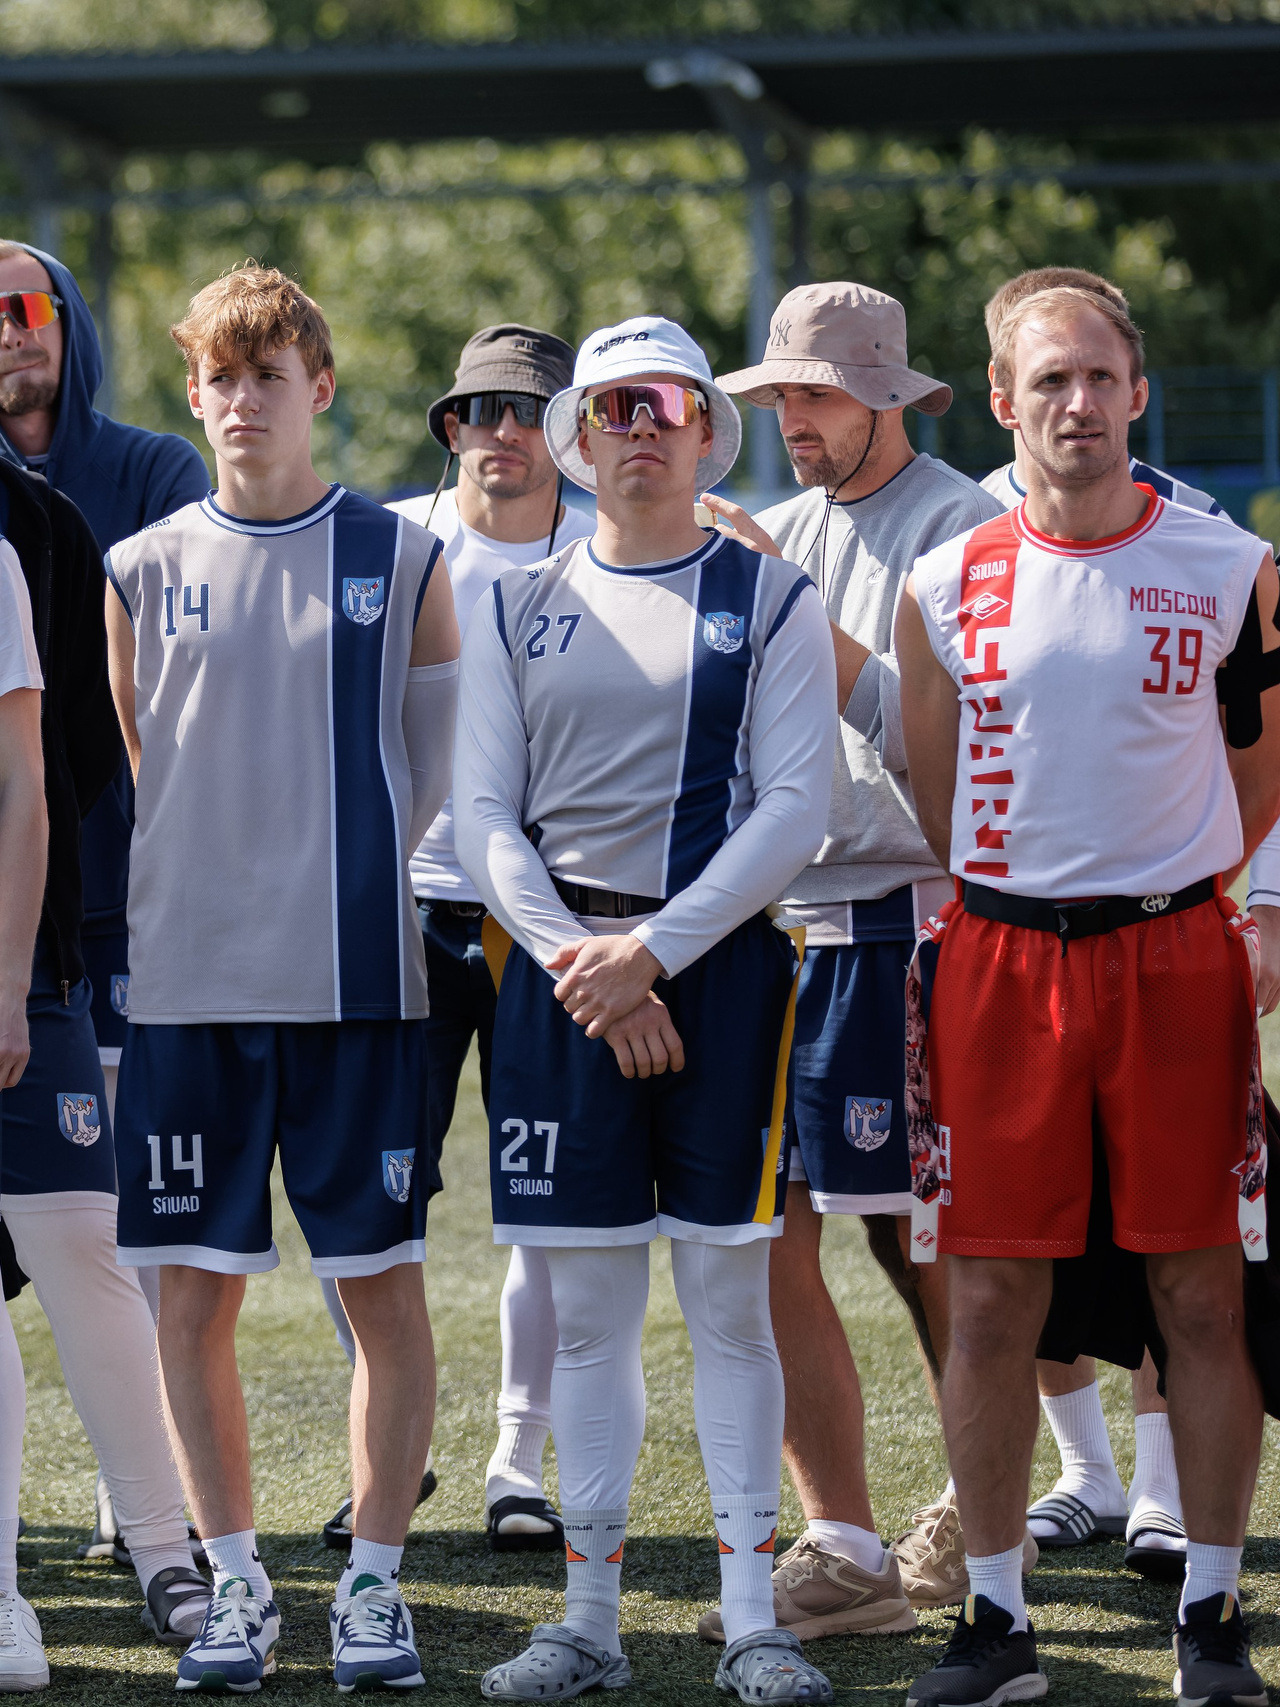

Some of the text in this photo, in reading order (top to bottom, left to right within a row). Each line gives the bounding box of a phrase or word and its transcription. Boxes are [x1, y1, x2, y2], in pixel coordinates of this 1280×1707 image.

[968, 559, 1008, 581] SQUAD
[163, 581, 211, 638] 14
[1129, 586, 1217, 621] MOSCOW
[525, 612, 585, 662] 27
[1142, 625, 1204, 696] 39
[960, 626, 1016, 890] SPART
[147, 1133, 204, 1190] 14
[500, 1117, 560, 1174] 27
[152, 1195, 200, 1215] SQUAD
[509, 1178, 553, 1196] SQUAD
